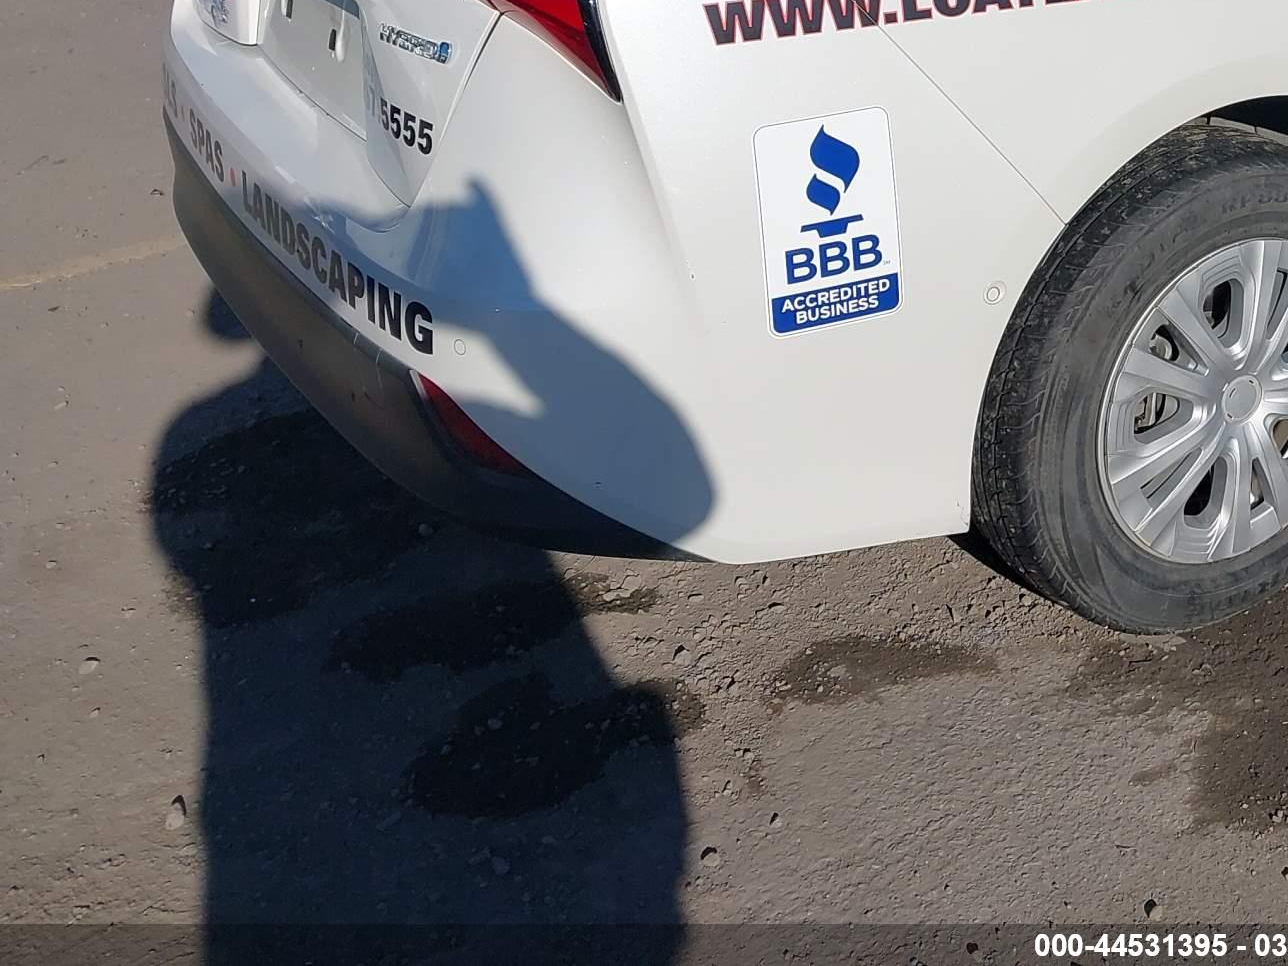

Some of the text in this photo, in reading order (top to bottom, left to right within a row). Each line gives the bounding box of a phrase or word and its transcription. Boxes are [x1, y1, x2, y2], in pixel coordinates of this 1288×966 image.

[189, 107, 225, 183] SPAS
[241, 169, 434, 356] LANDSCAPING
[785, 234, 883, 285] BBB
[781, 278, 890, 313] ACCREDITED
[795, 295, 879, 324] BUSINESS
